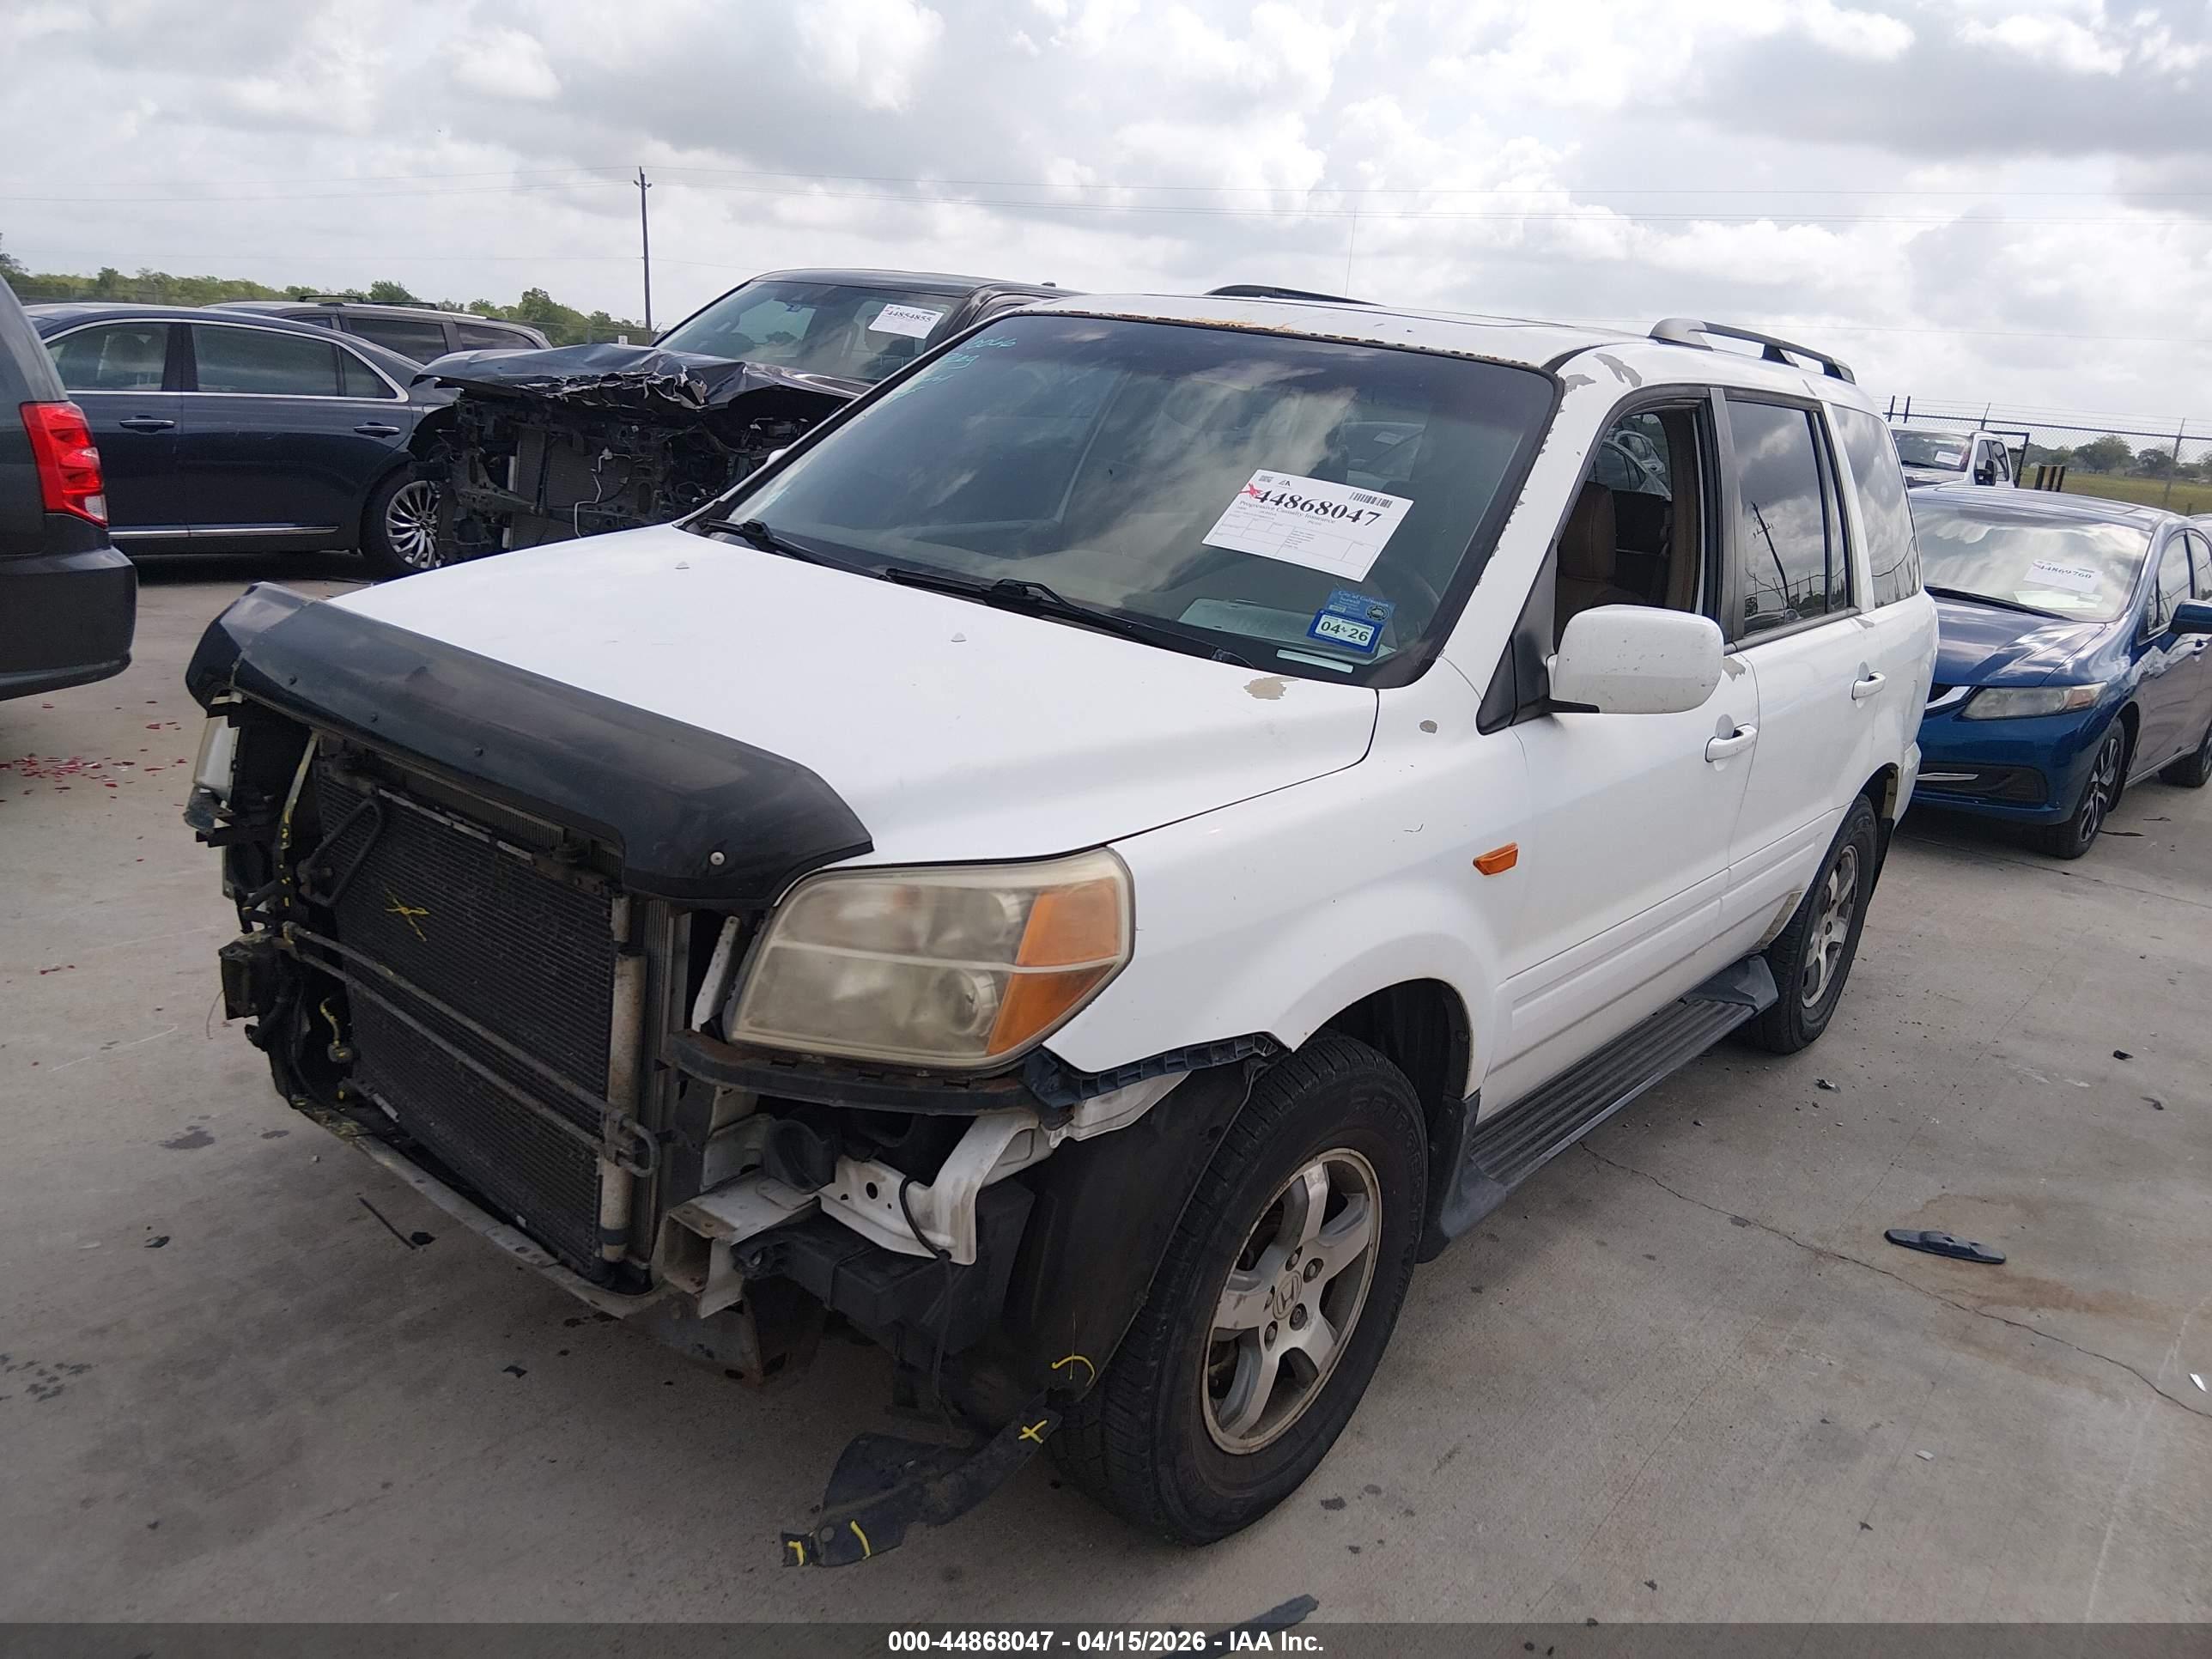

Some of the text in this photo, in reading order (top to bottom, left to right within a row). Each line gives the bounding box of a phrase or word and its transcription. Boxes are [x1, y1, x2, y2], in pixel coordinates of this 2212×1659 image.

[886, 310, 933, 322] 44854855
[1239, 501, 1275, 512] Progressive
[1255, 489, 1382, 526] 44868047
[1321, 621, 1369, 641] 04 26
